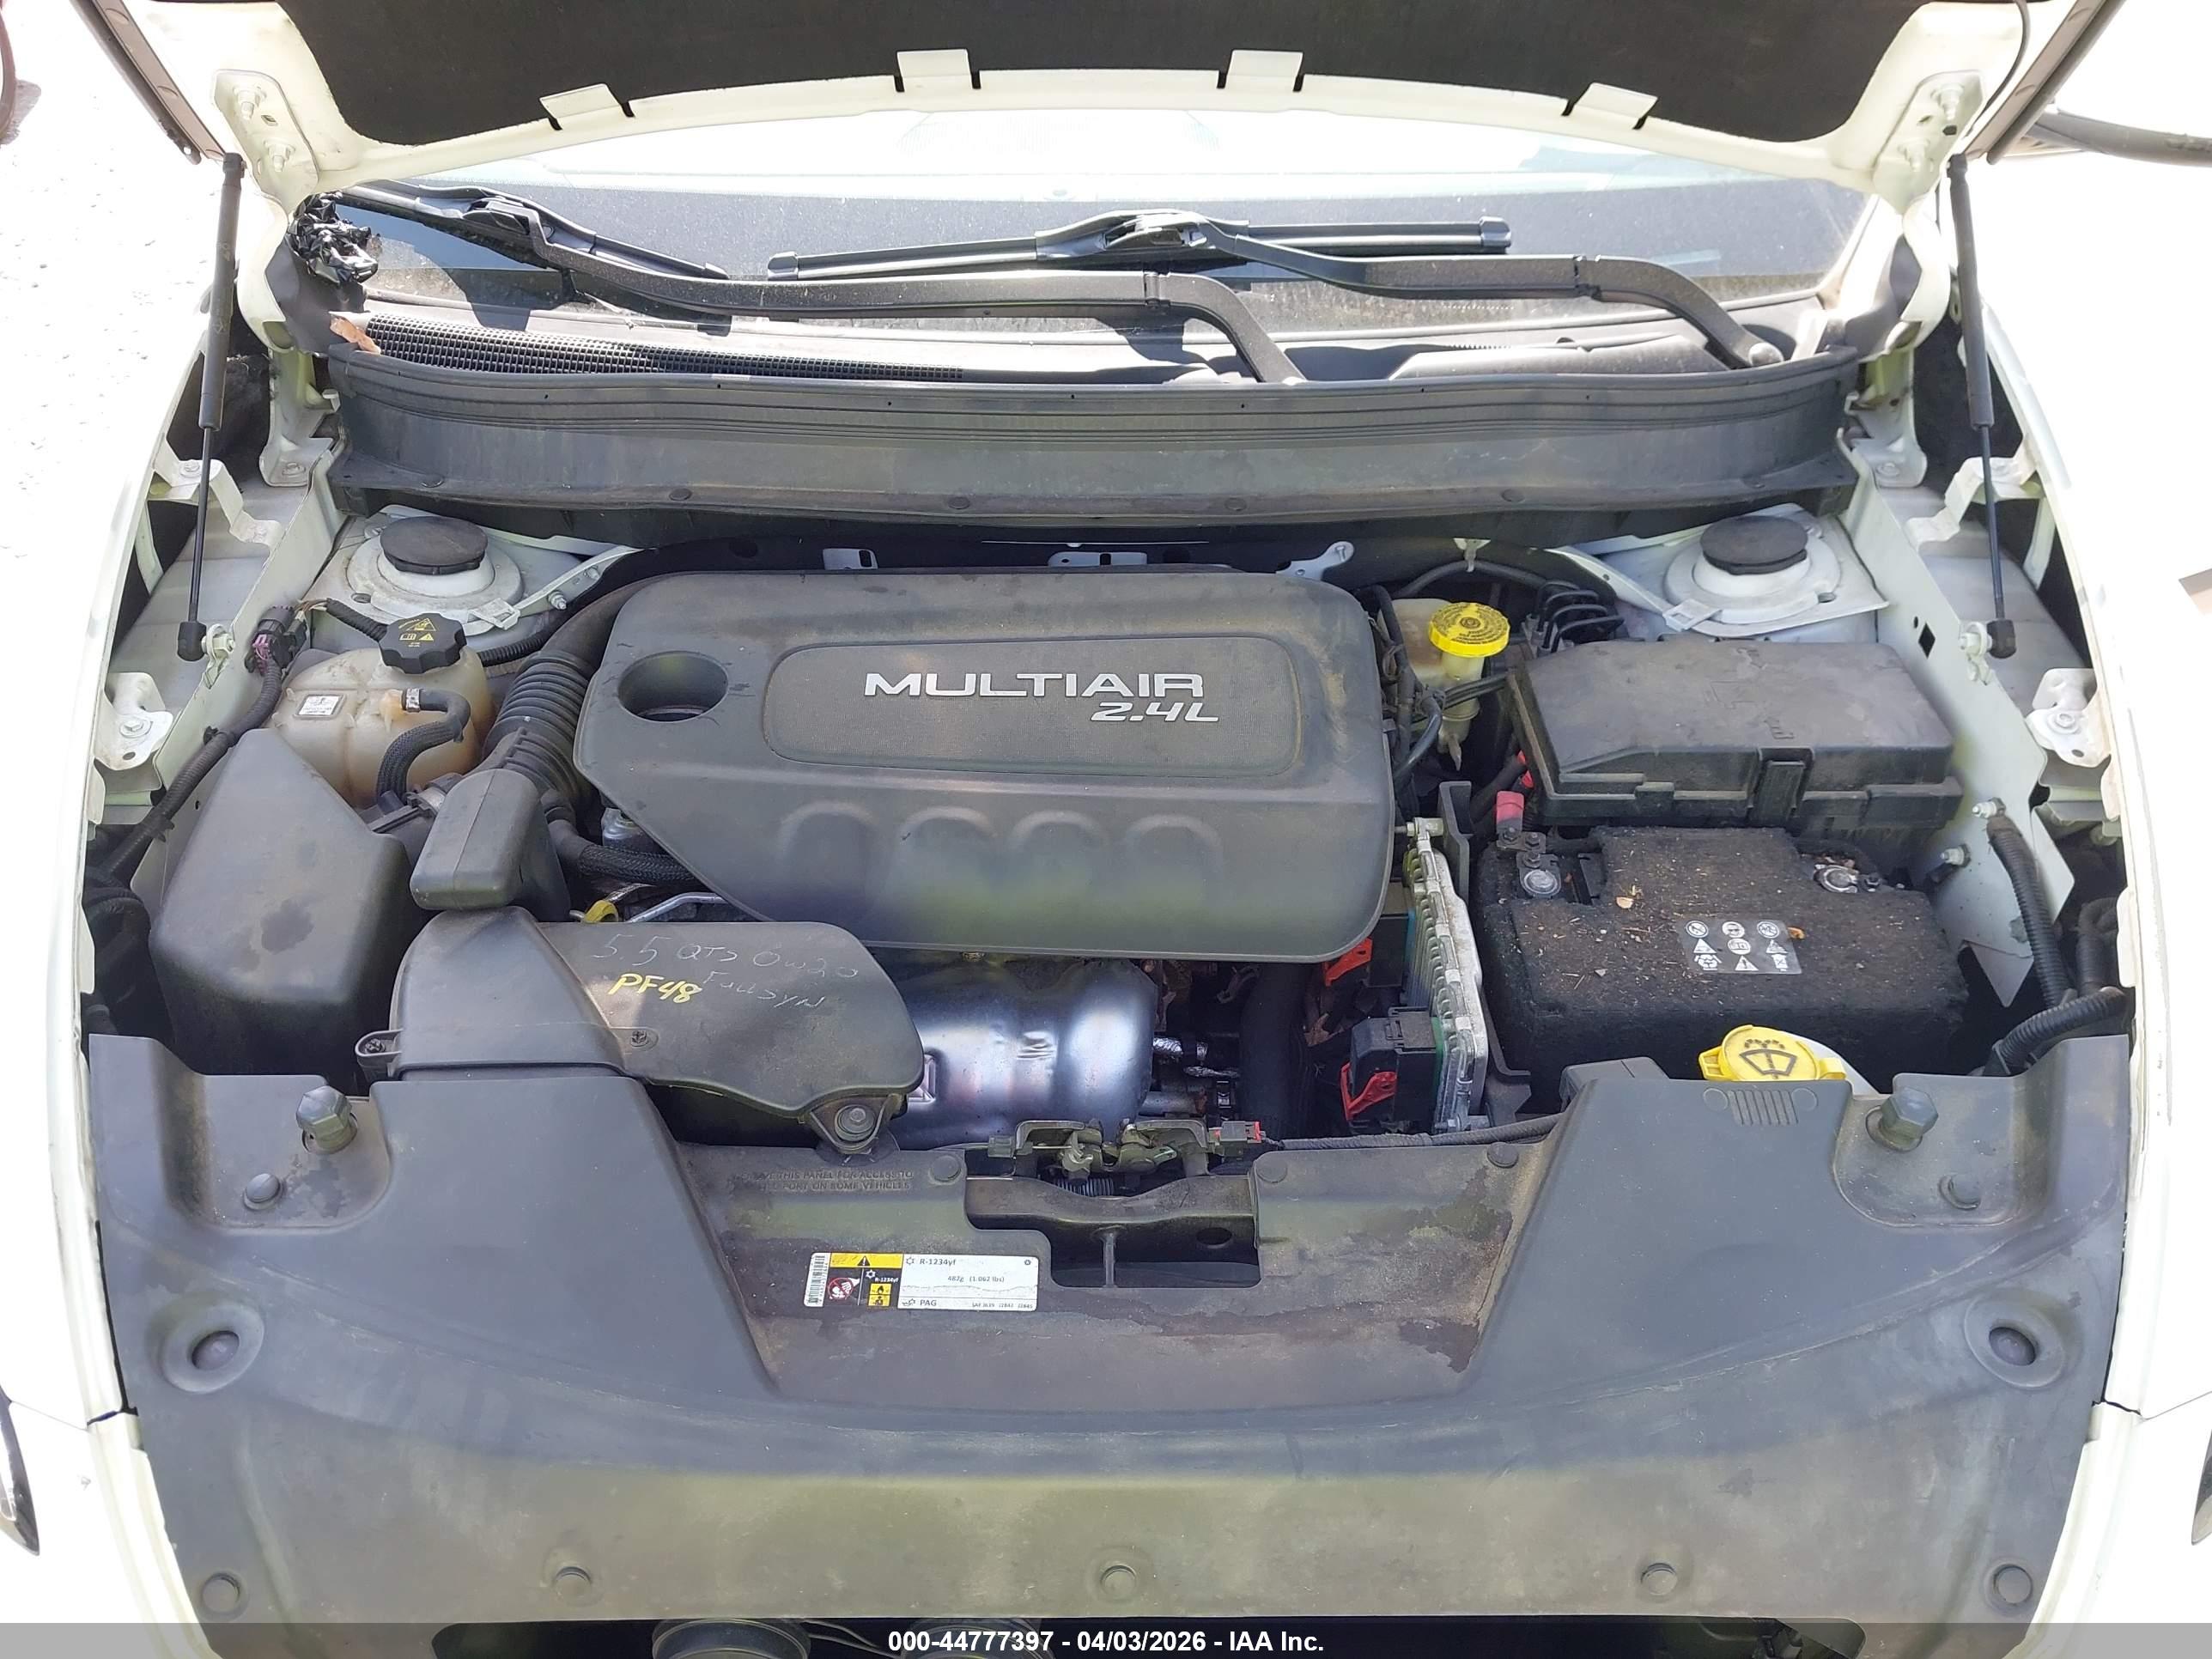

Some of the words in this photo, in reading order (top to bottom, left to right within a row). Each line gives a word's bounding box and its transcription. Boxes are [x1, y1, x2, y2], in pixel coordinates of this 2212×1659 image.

[864, 672, 1203, 697] MULTIAIR
[1091, 702, 1218, 721] 2.4L
[592, 933, 672, 966] 5.5
[608, 973, 703, 1004] PF48
[919, 1257, 957, 1269] R-1234yf
[920, 1298, 938, 1308] PAG
